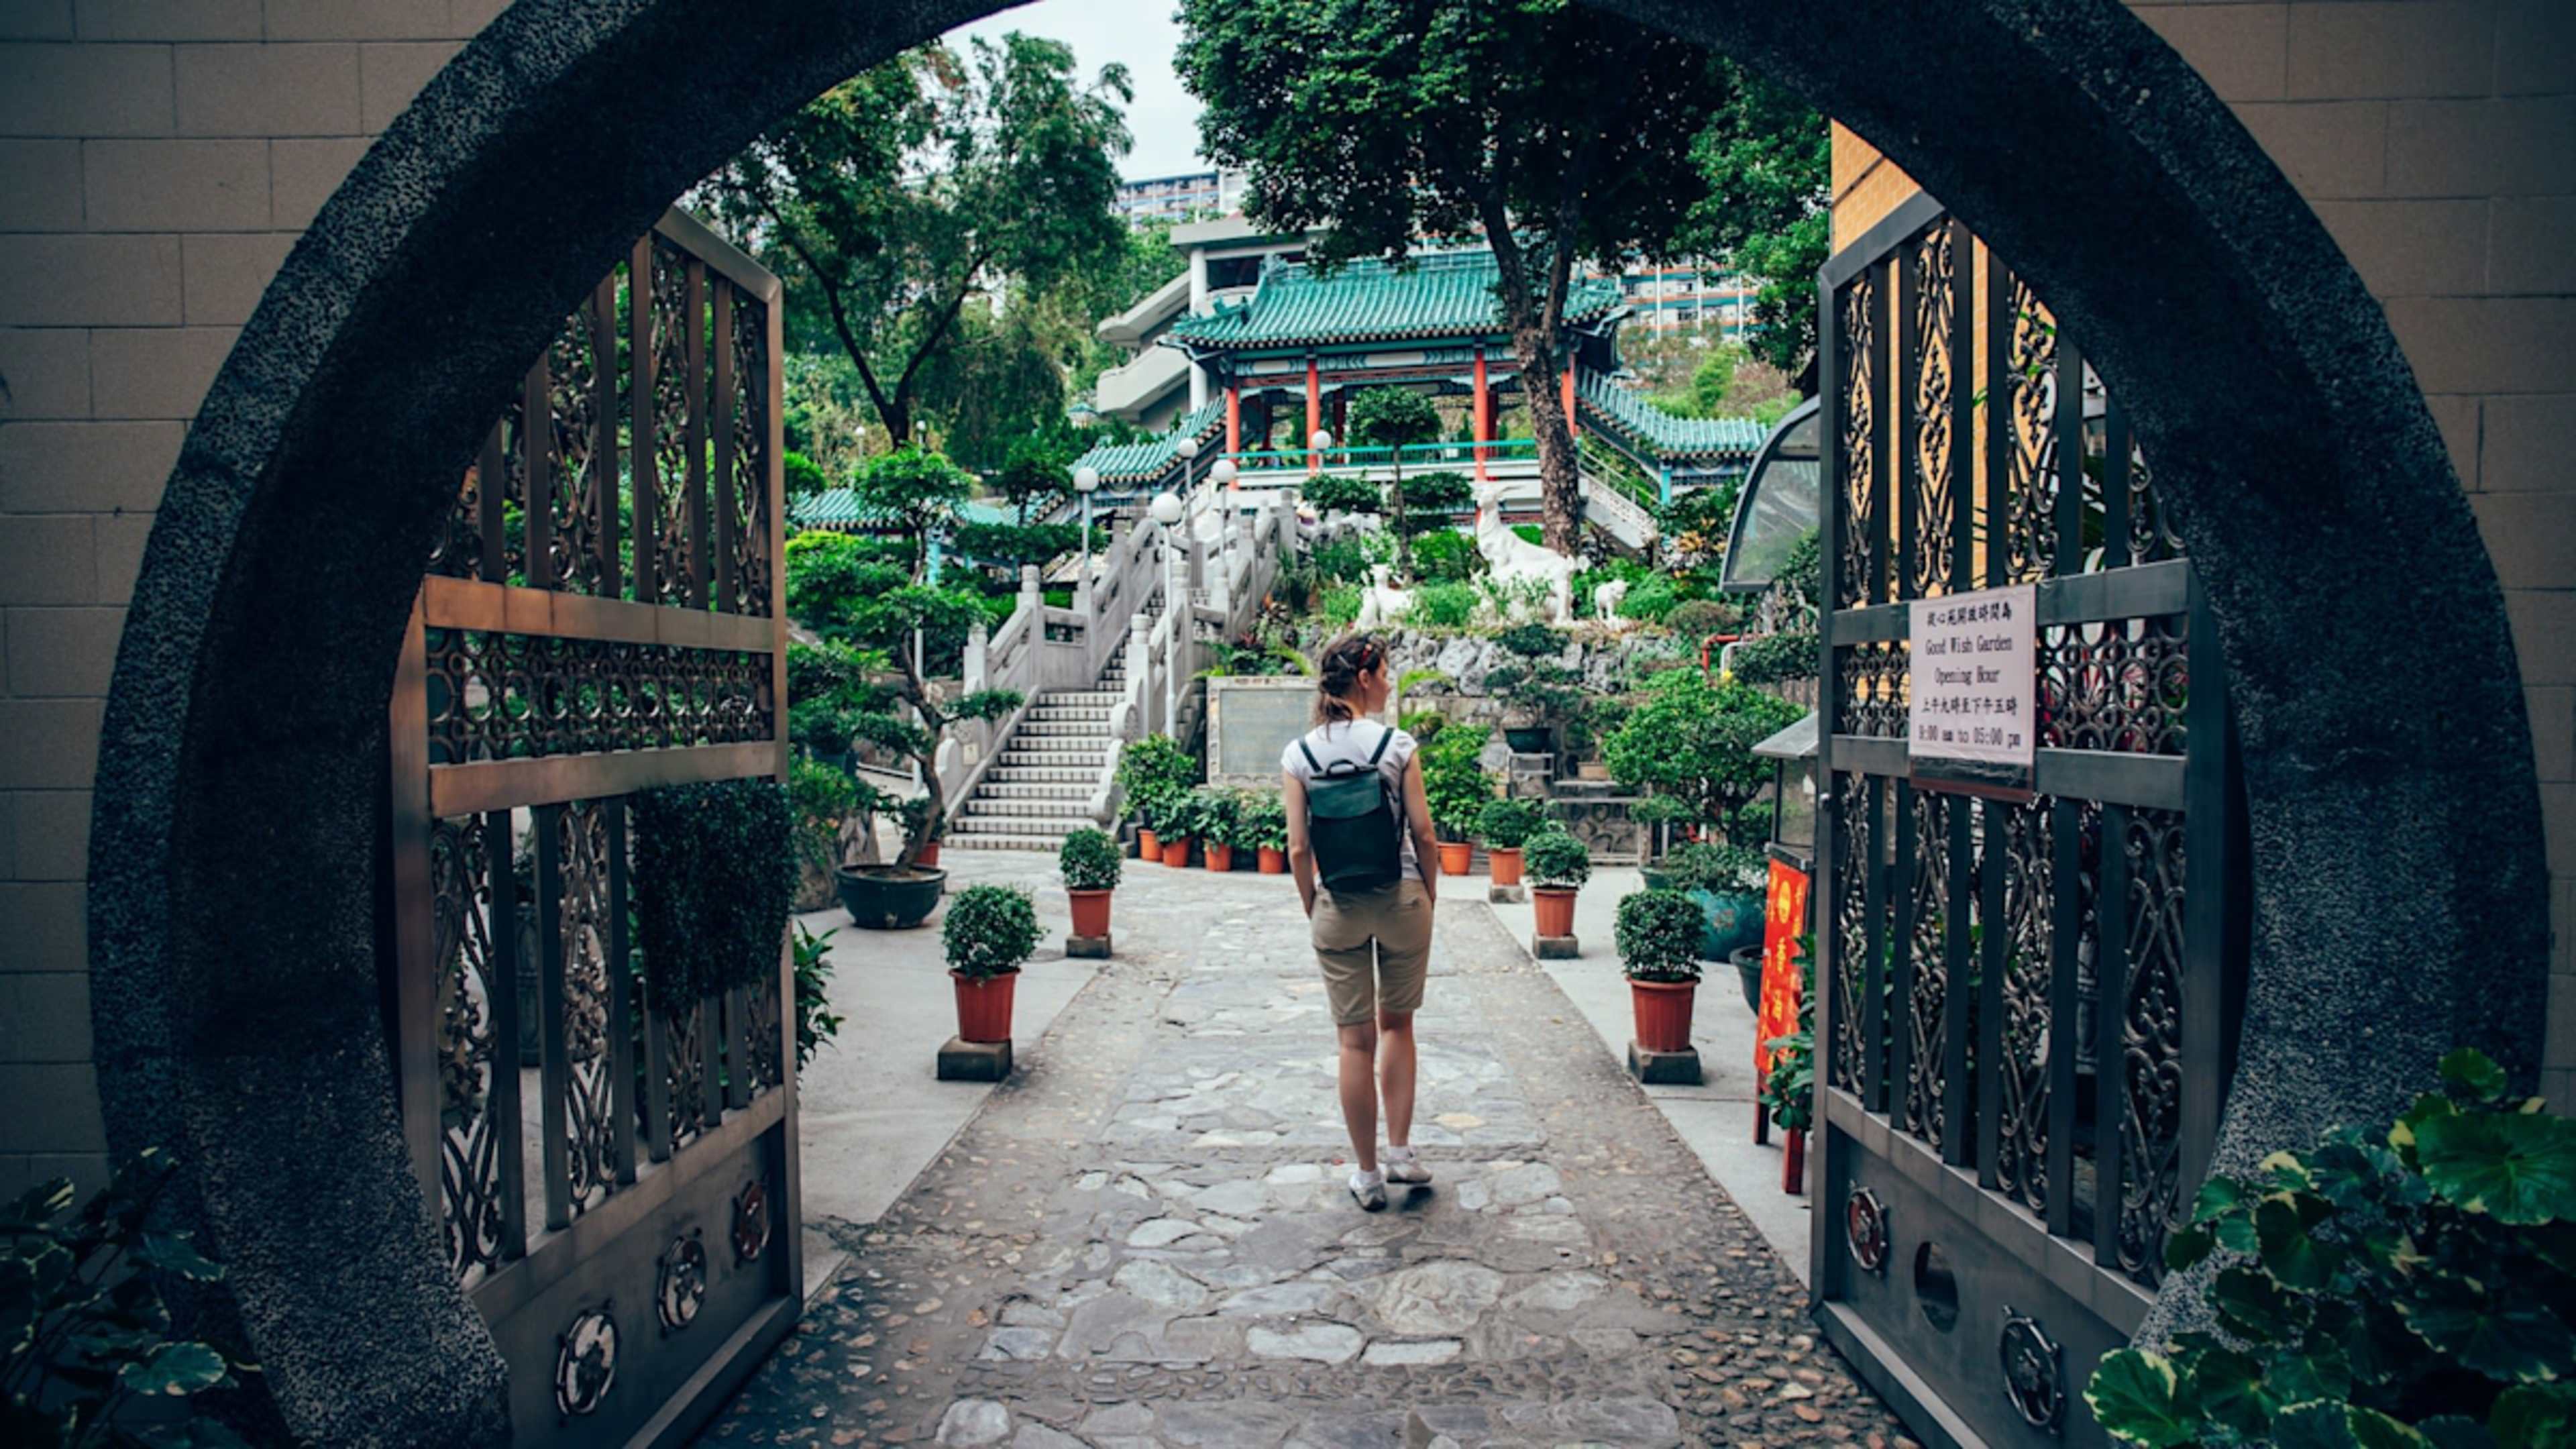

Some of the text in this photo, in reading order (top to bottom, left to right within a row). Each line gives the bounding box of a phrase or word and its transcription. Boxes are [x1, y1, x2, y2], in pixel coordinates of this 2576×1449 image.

[1926, 633, 2012, 656] Good Wish Garden
[1935, 665, 2000, 686] Opening Hour
[1943, 729, 1953, 743] am
[1957, 729, 1969, 744] to
[1974, 727, 2003, 746] 05:00
[2008, 733, 2021, 749] pm
